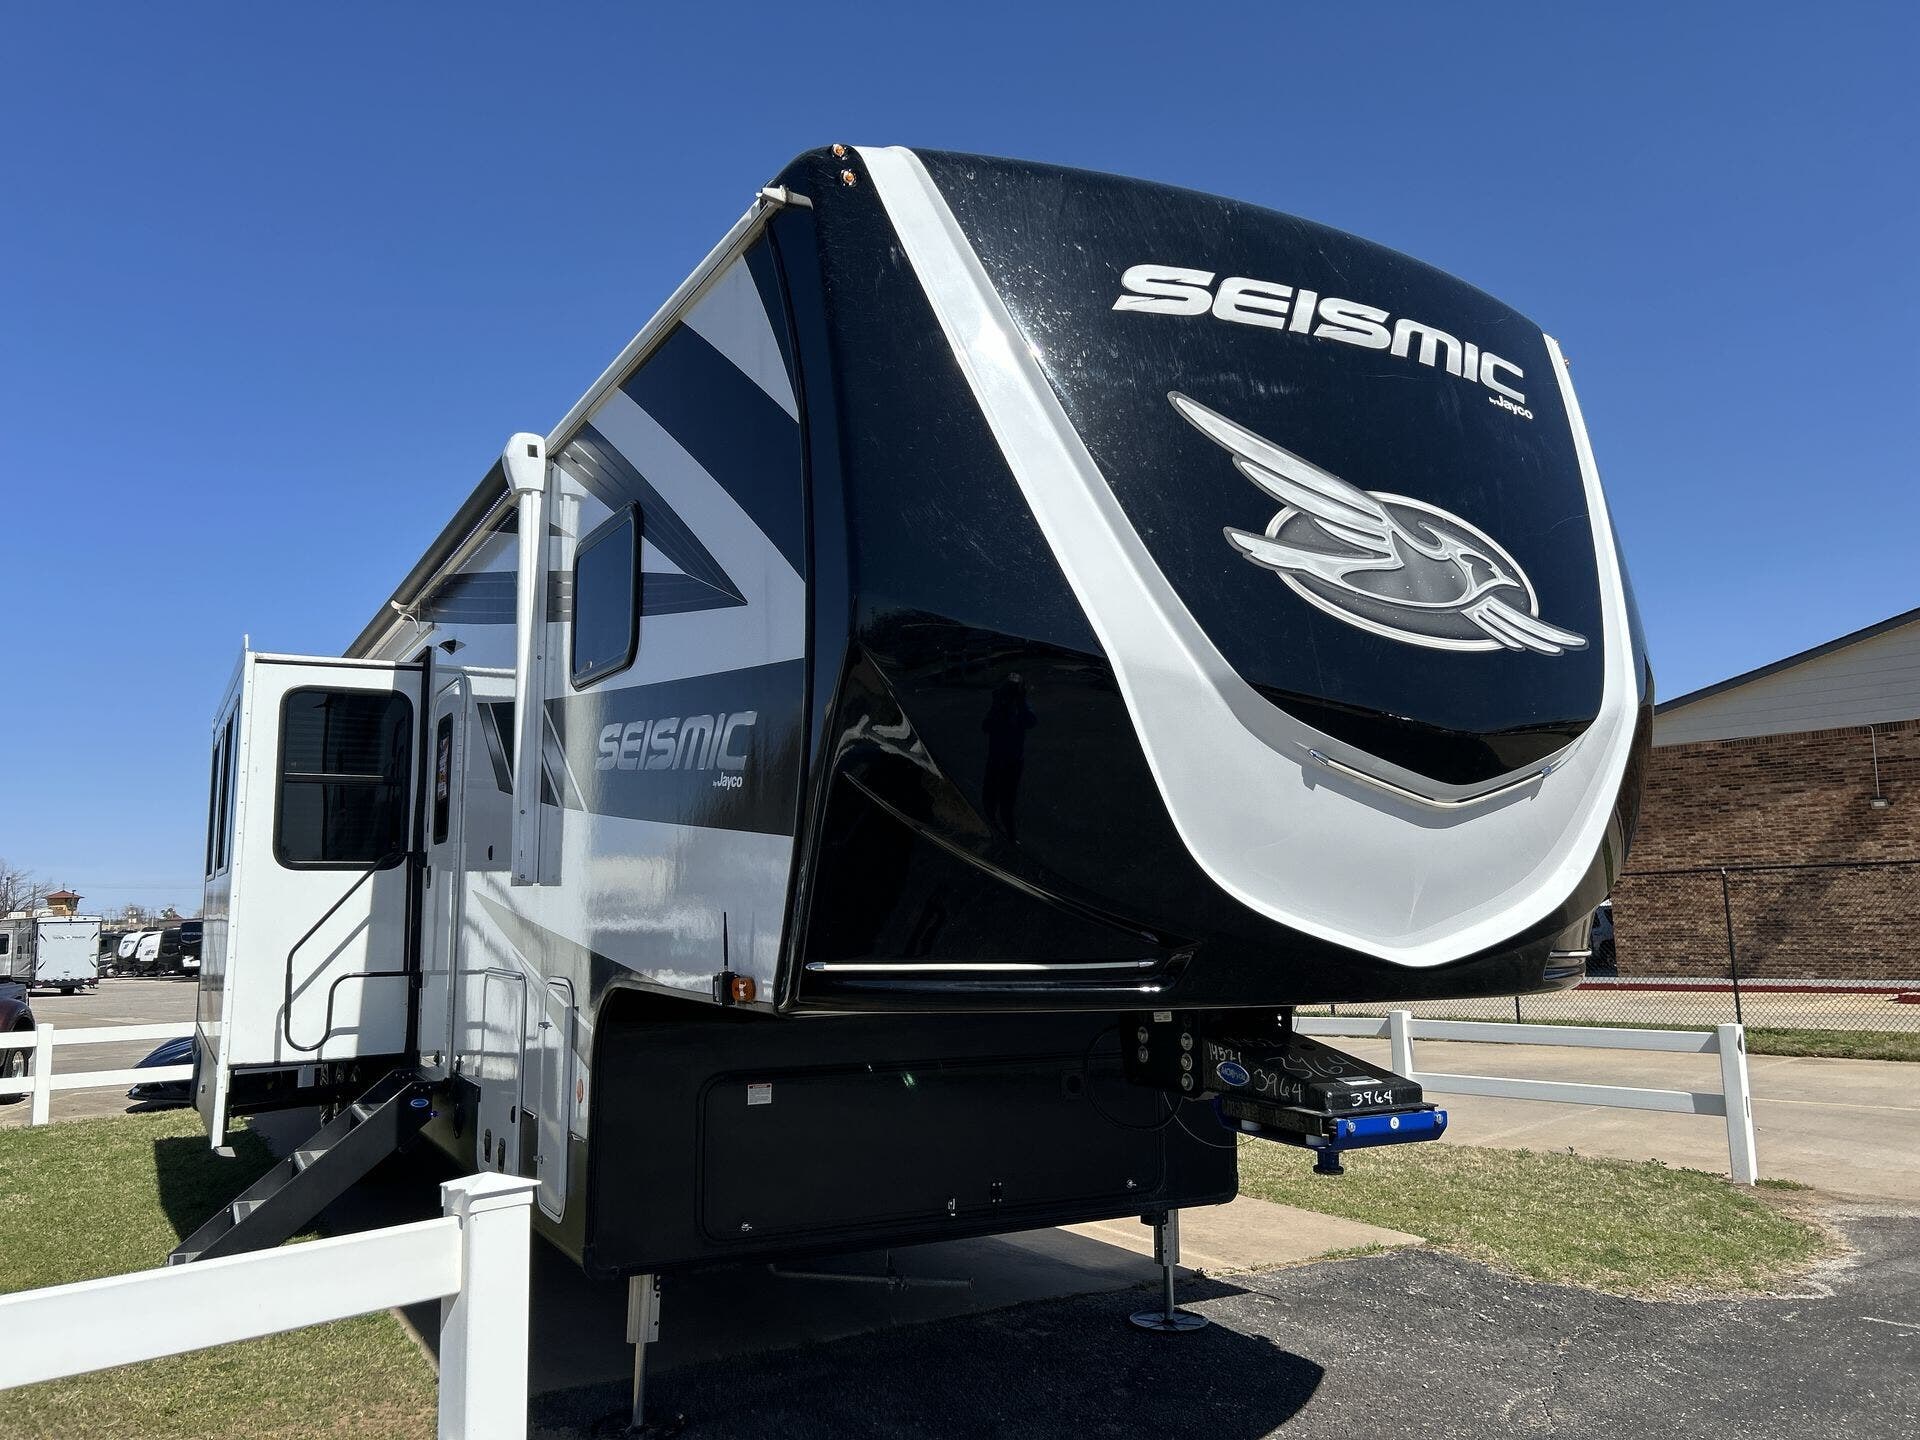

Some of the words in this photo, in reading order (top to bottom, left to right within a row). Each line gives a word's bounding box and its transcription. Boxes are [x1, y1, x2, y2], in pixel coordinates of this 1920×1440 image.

[1112, 264, 1525, 404] SEISMIC
[1497, 395, 1533, 420] Jayco
[595, 710, 758, 771] SEISMIC
[717, 771, 743, 791] Jayco
[1253, 1068, 1303, 1103] 3964
[1350, 1089, 1393, 1107] 3964
